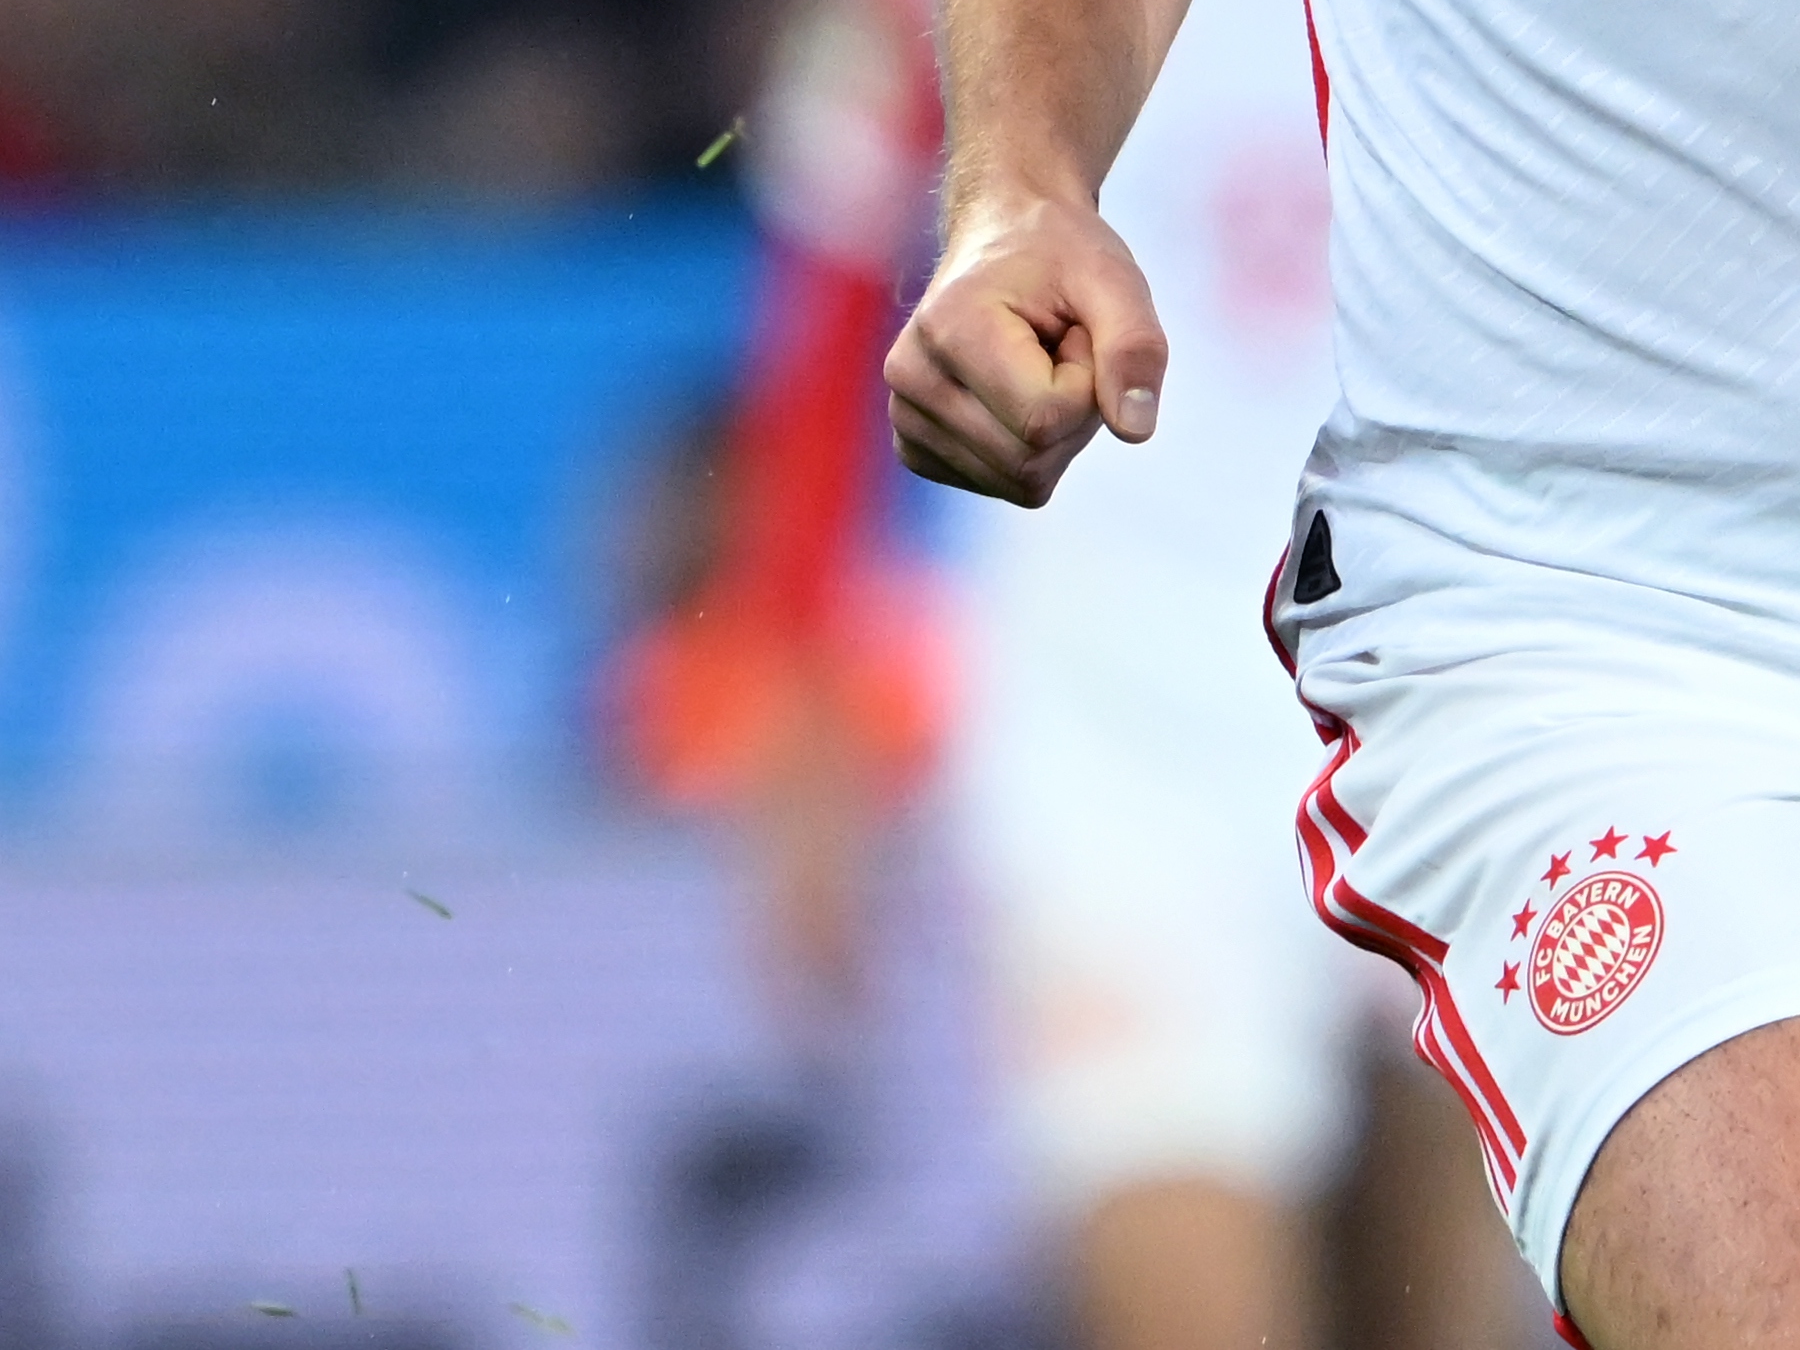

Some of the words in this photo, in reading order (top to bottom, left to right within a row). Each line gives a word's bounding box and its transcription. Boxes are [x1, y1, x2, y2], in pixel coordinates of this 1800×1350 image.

[1535, 946, 1553, 987] FC
[1546, 880, 1640, 939] BAYERN
[1550, 924, 1653, 1023] MÜNCHEN
